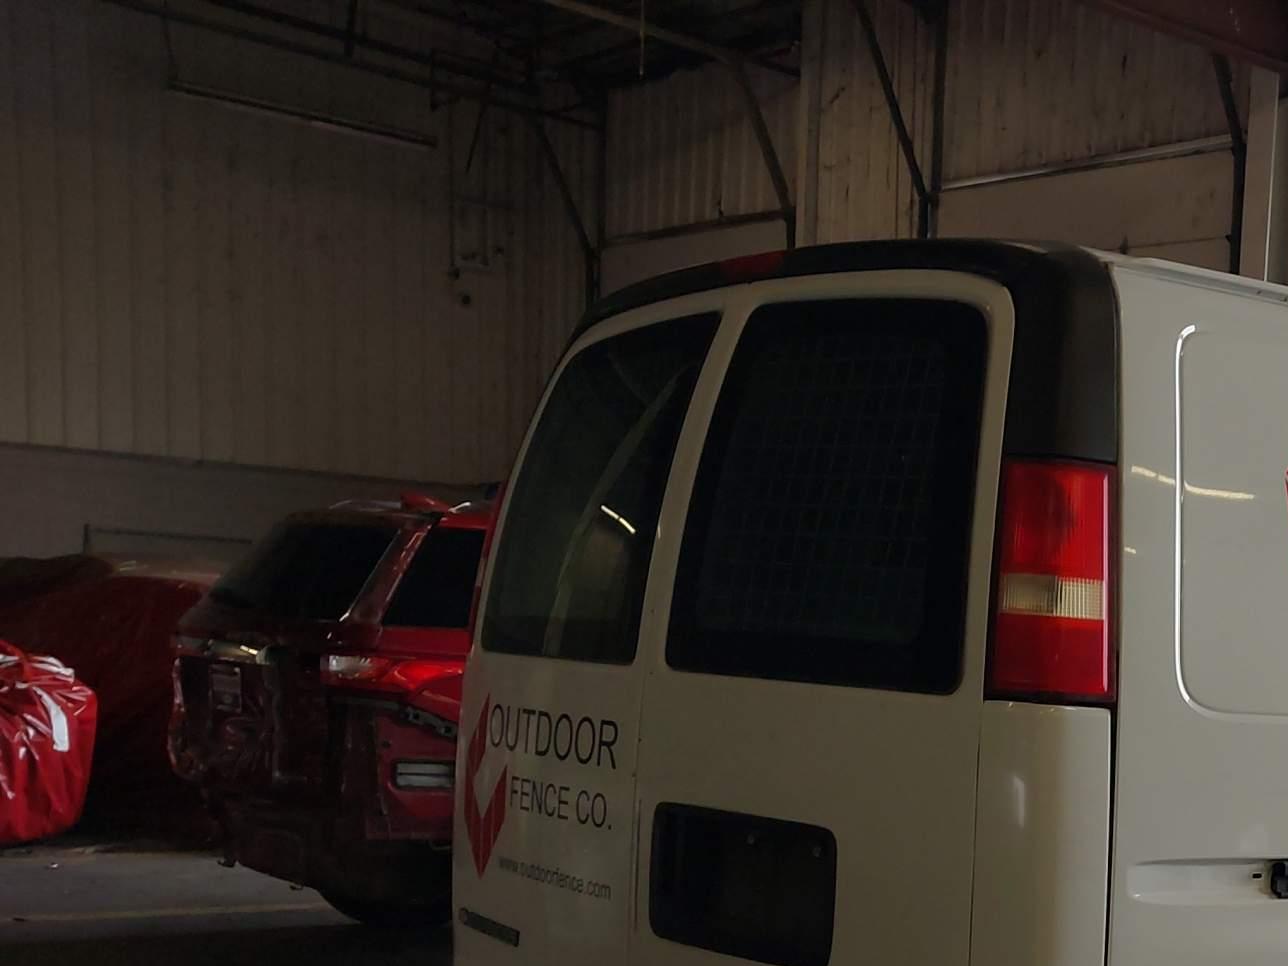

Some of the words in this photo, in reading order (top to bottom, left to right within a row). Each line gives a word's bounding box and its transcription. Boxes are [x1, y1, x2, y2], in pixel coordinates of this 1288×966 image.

[490, 704, 618, 769] OUTDOOR
[509, 776, 570, 820] FENCE
[576, 789, 613, 831] CO.
